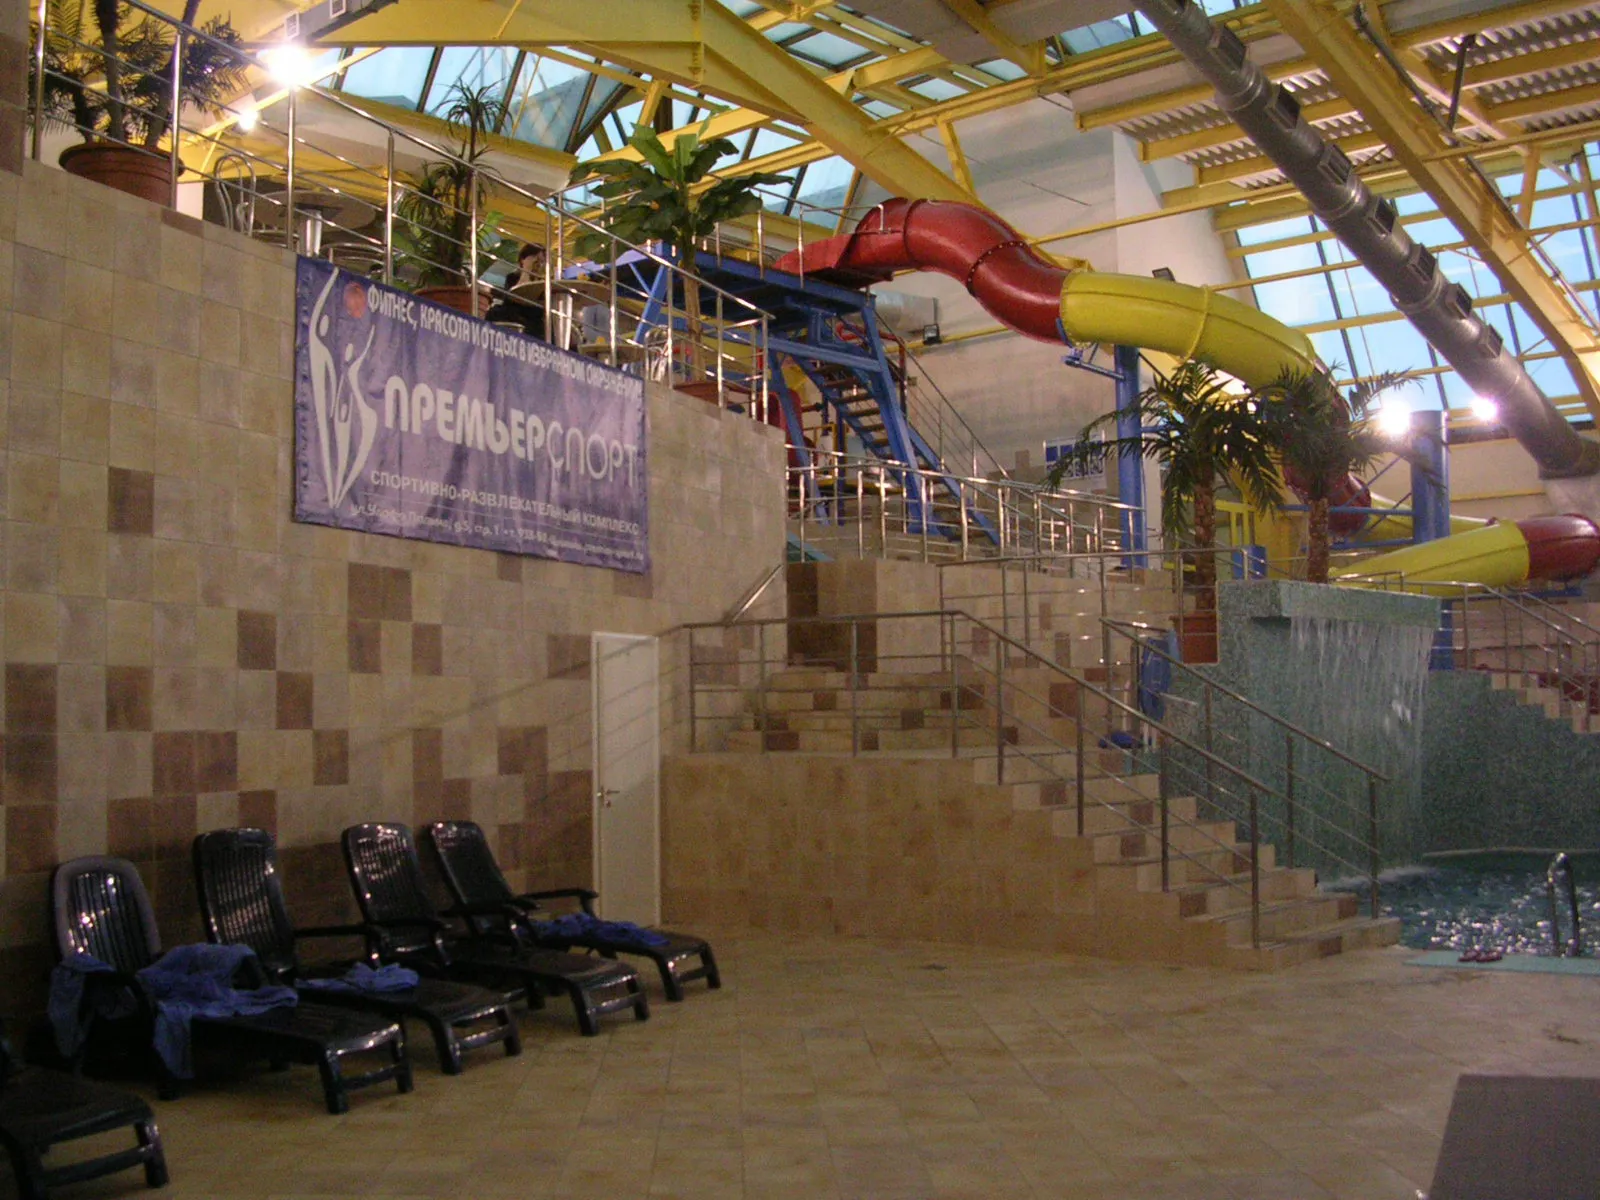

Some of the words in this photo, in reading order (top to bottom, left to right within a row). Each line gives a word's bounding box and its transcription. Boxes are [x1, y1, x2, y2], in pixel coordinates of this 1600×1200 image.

[367, 284, 418, 331] ФИТНЕС,
[420, 303, 471, 343] КРАСОТА
[471, 321, 481, 346] И
[480, 323, 519, 359] ОТДЫХ
[519, 339, 527, 361] В
[527, 341, 586, 382] ИЗБРАННОМ
[370, 470, 581, 522] СПОРТИВНО-РАЗВЛЕКАТЕЛЬНЫЙ
[582, 511, 640, 536] КОМПЛЕКС
